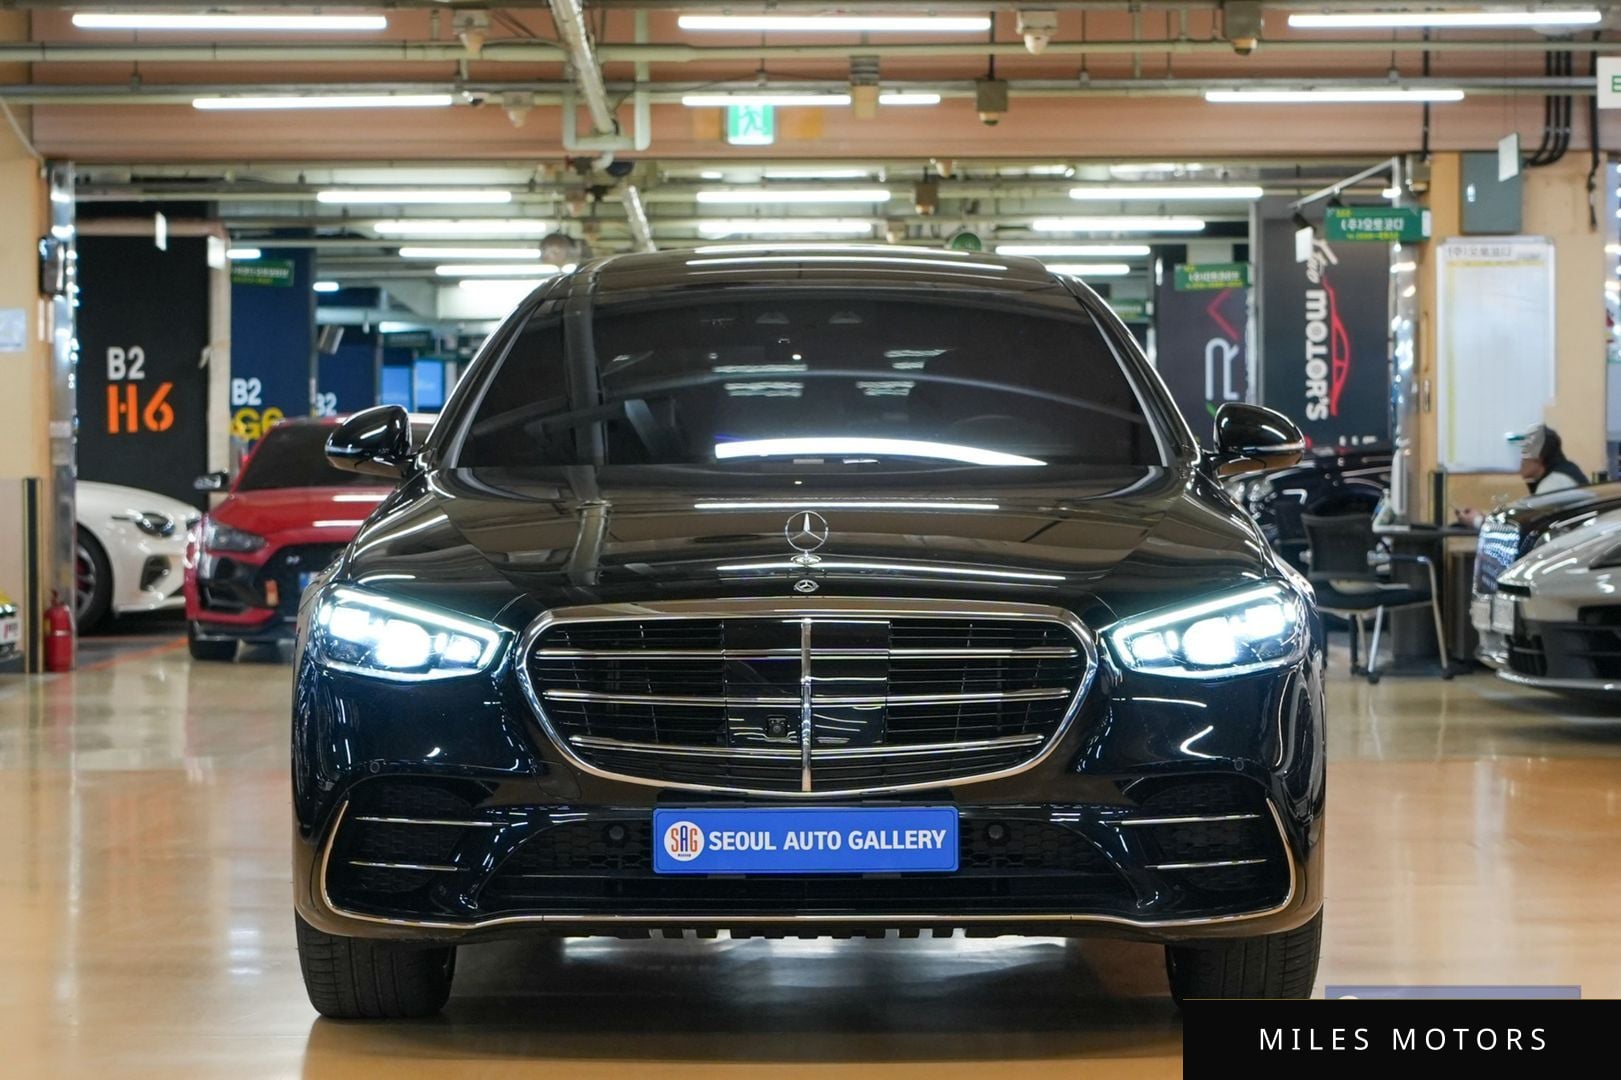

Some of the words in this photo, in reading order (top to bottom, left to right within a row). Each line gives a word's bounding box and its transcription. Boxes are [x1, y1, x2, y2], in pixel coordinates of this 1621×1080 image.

[107, 346, 145, 380] B2
[232, 377, 262, 406] B2
[107, 382, 174, 434] H6
[671, 825, 698, 852] SAG
[709, 831, 777, 851] SEOUL
[783, 831, 842, 850] AUTO
[848, 829, 947, 850] GALLERY
